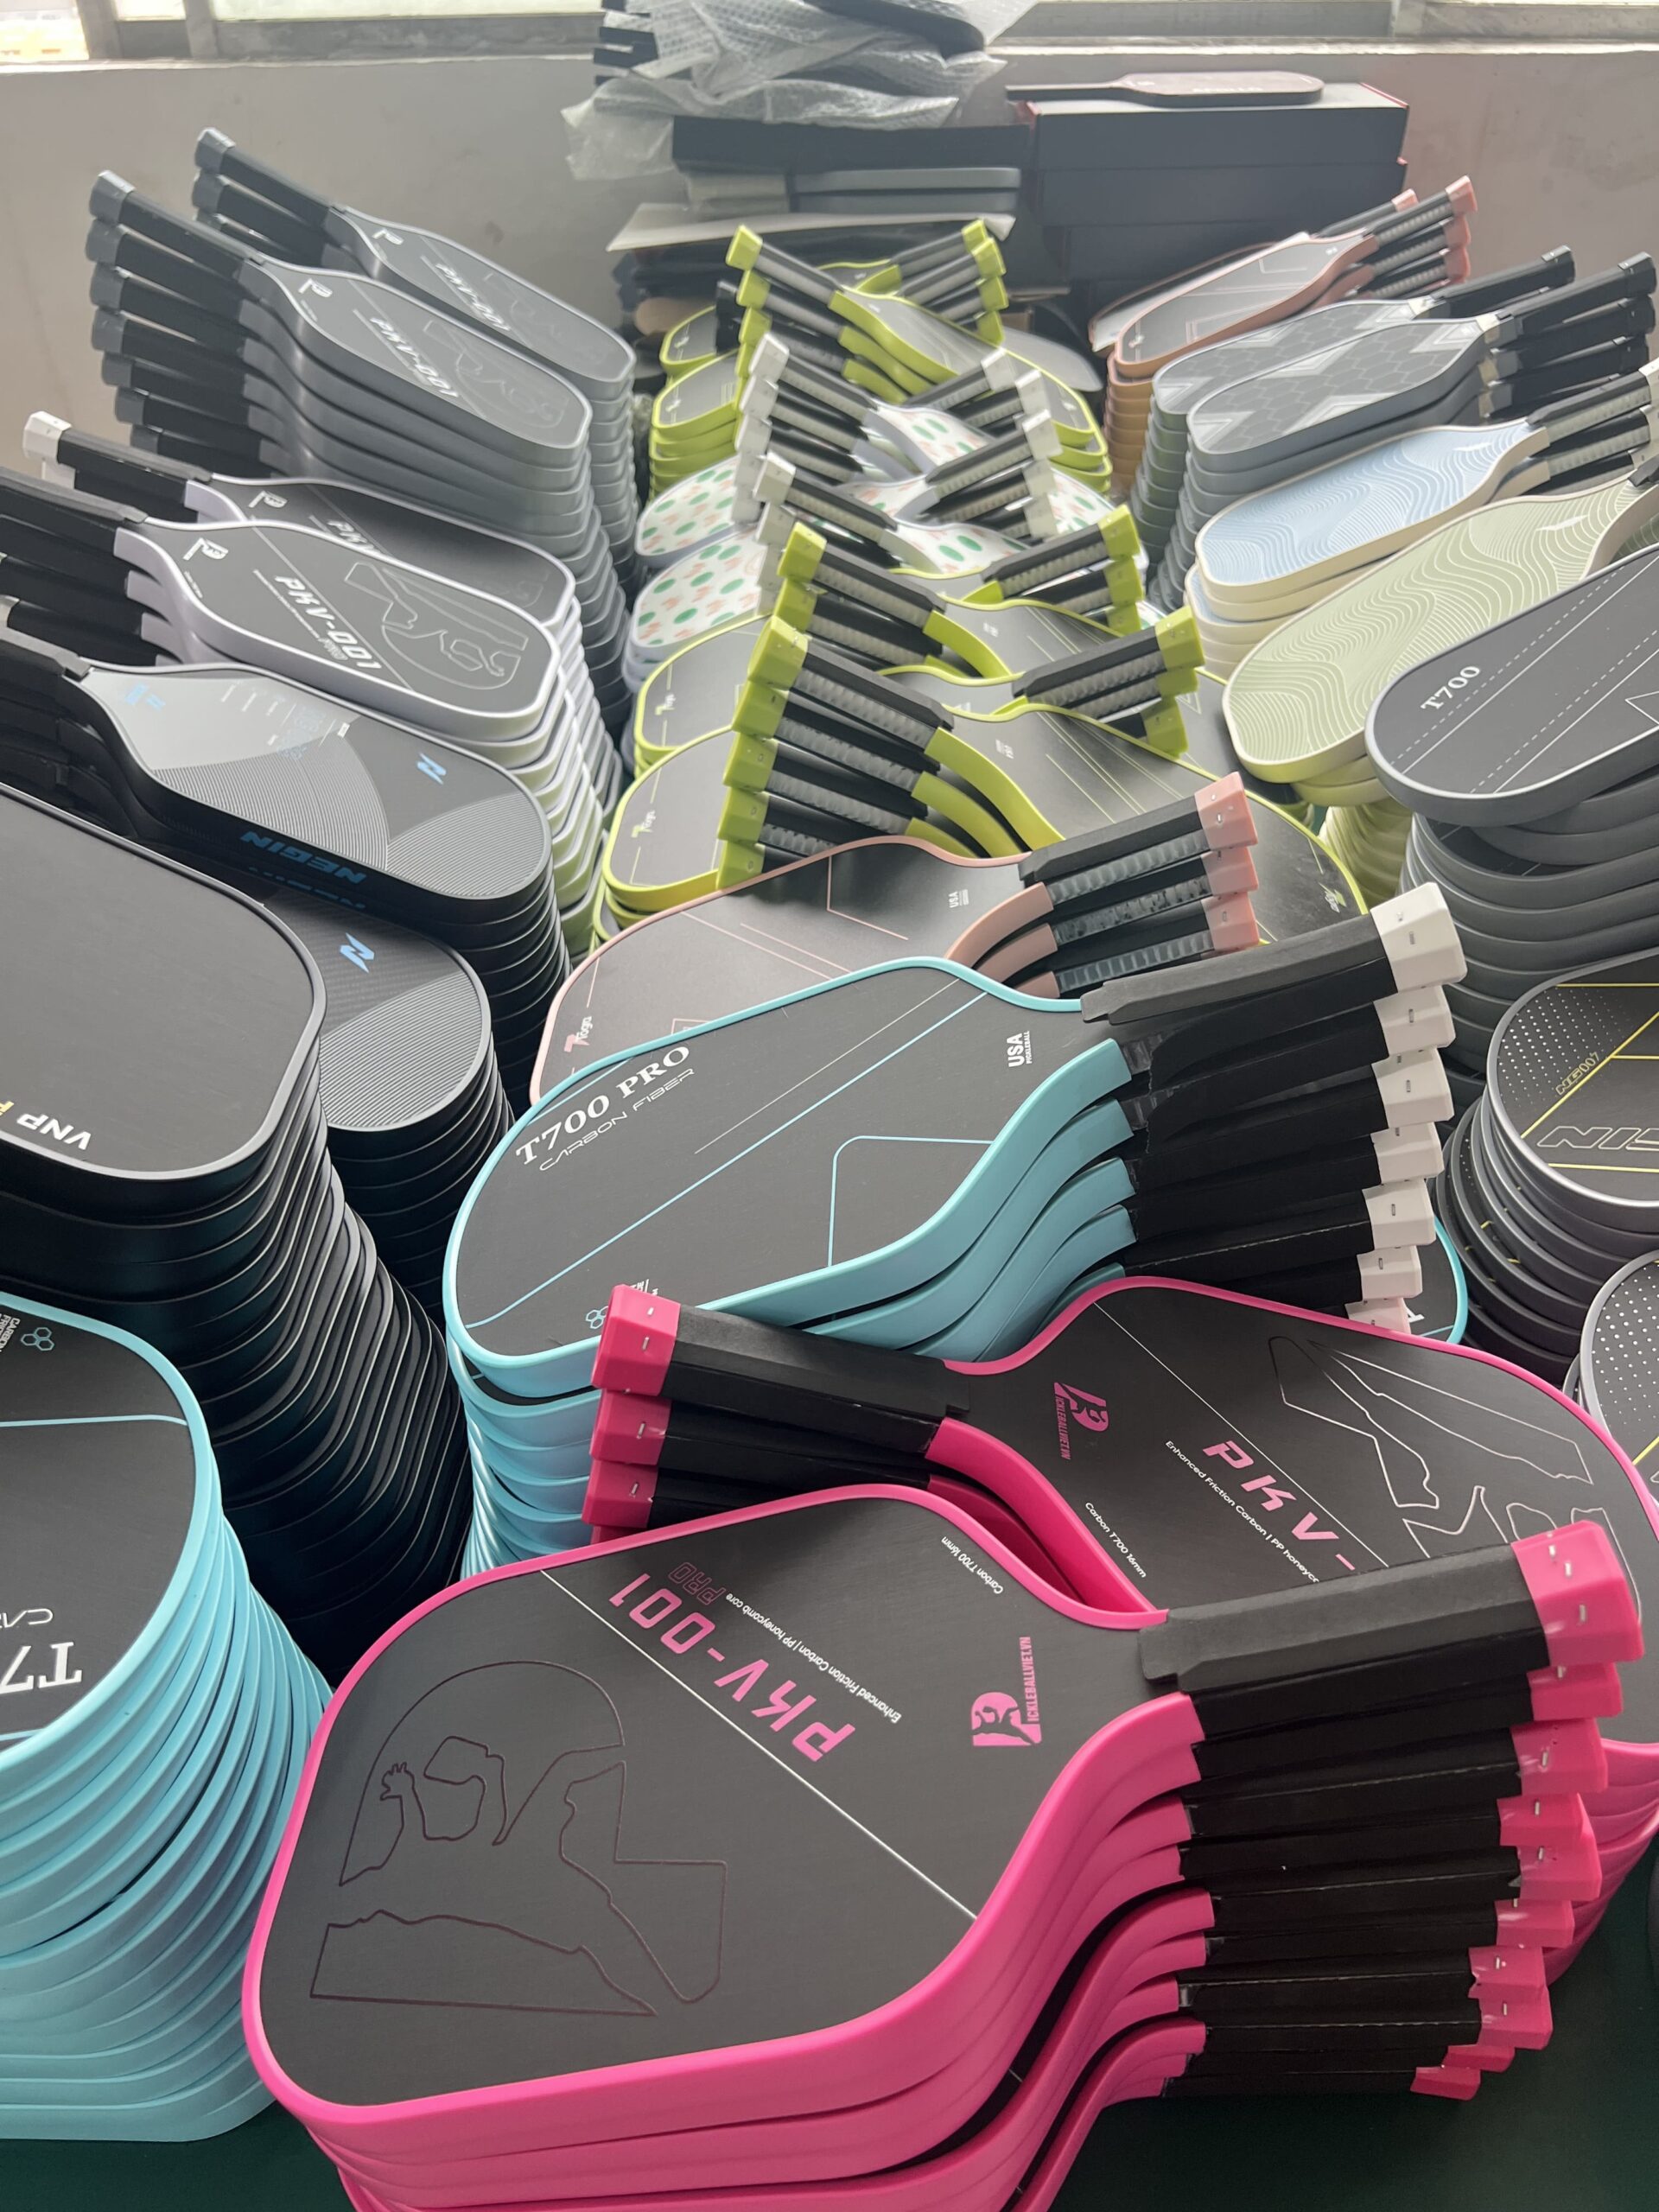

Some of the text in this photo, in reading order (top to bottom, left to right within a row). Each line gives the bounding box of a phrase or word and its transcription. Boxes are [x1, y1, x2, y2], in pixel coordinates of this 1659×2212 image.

[370, 317, 459, 397] PKV-001
[275, 576, 382, 669] PKV-001
[1420, 666, 1480, 709] T700
[239, 830, 367, 884] NEGIN
[1007, 1033, 1025, 1068] USA
[515, 1046, 690, 1165] T700 PRO
[539, 1068, 695, 1171] CARBON FIBER
[16, 1113, 92, 1151] VNP
[1166, 1440, 1206, 1478] Enhanced
[1205, 1477, 1236, 1506] Friction
[1236, 1505, 1267, 1535] Carbon
[1270, 1538, 1285, 1550] PP
[1085, 1502, 1147, 1578] Carbon T700 16mm
[668, 1562, 726, 1605] PRO
[941, 1536, 1004, 1594] Carbon T700 16mm
[725, 1592, 744, 1608] core
[742, 1604, 786, 1640] honeycomb
[782, 1636, 797, 1649] PP
[608, 1573, 855, 1762] PKV-001
[798, 1644, 829, 1672] Carbon
[828, 1665, 860, 1694] Friction
[855, 1688, 902, 1724] Enhanced
